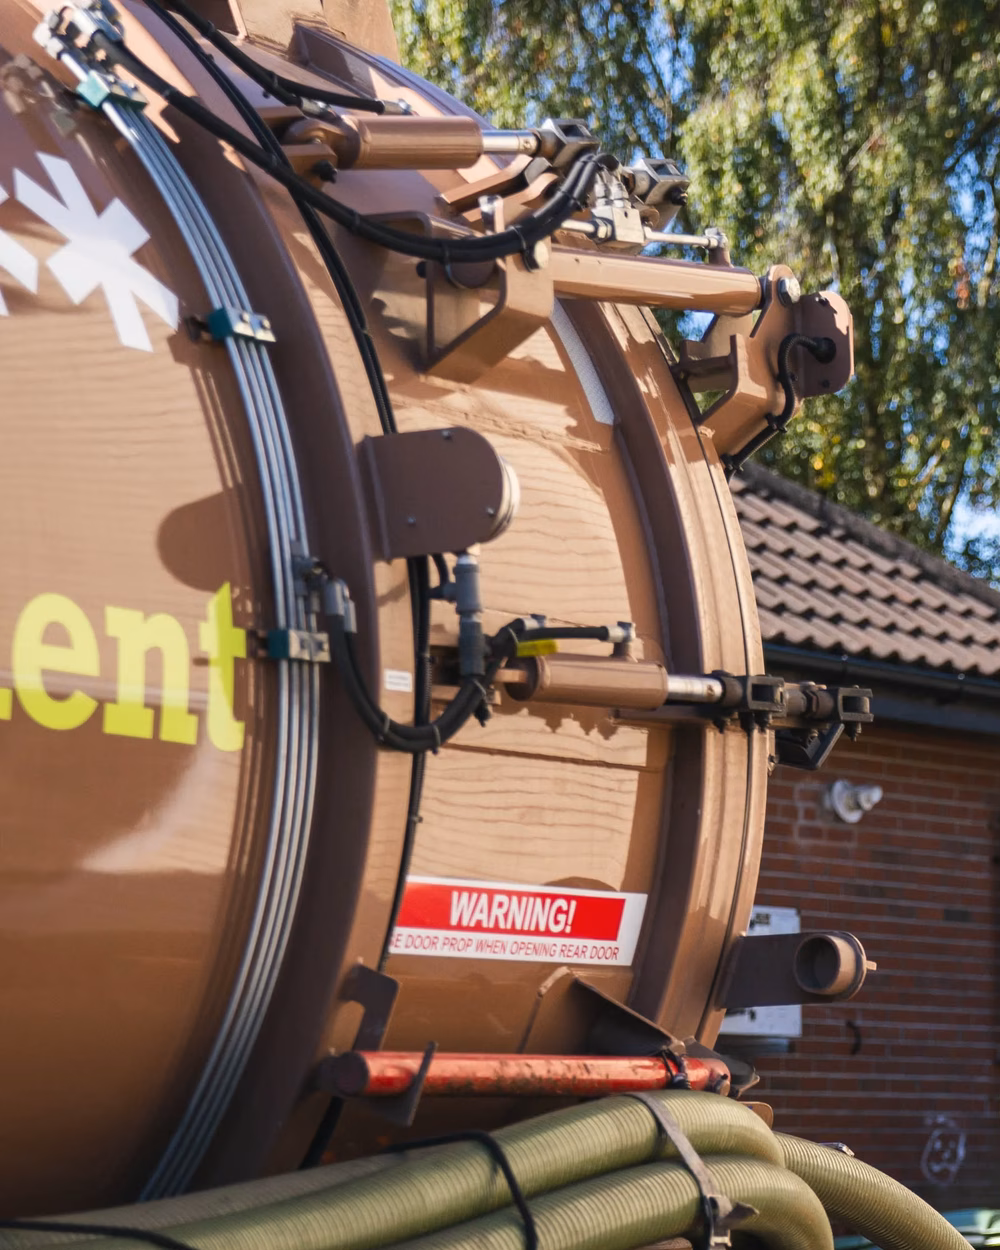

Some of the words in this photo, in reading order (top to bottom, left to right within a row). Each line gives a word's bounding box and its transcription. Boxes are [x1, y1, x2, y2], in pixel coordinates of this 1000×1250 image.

[450, 890, 577, 934] WARNING!
[404, 934, 439, 950] DOOR
[441, 936, 473, 952] PROP
[475, 939, 508, 954] WHEN
[510, 941, 558, 957] OPENING
[559, 943, 588, 959] REAR
[589, 945, 619, 960] DOOR
